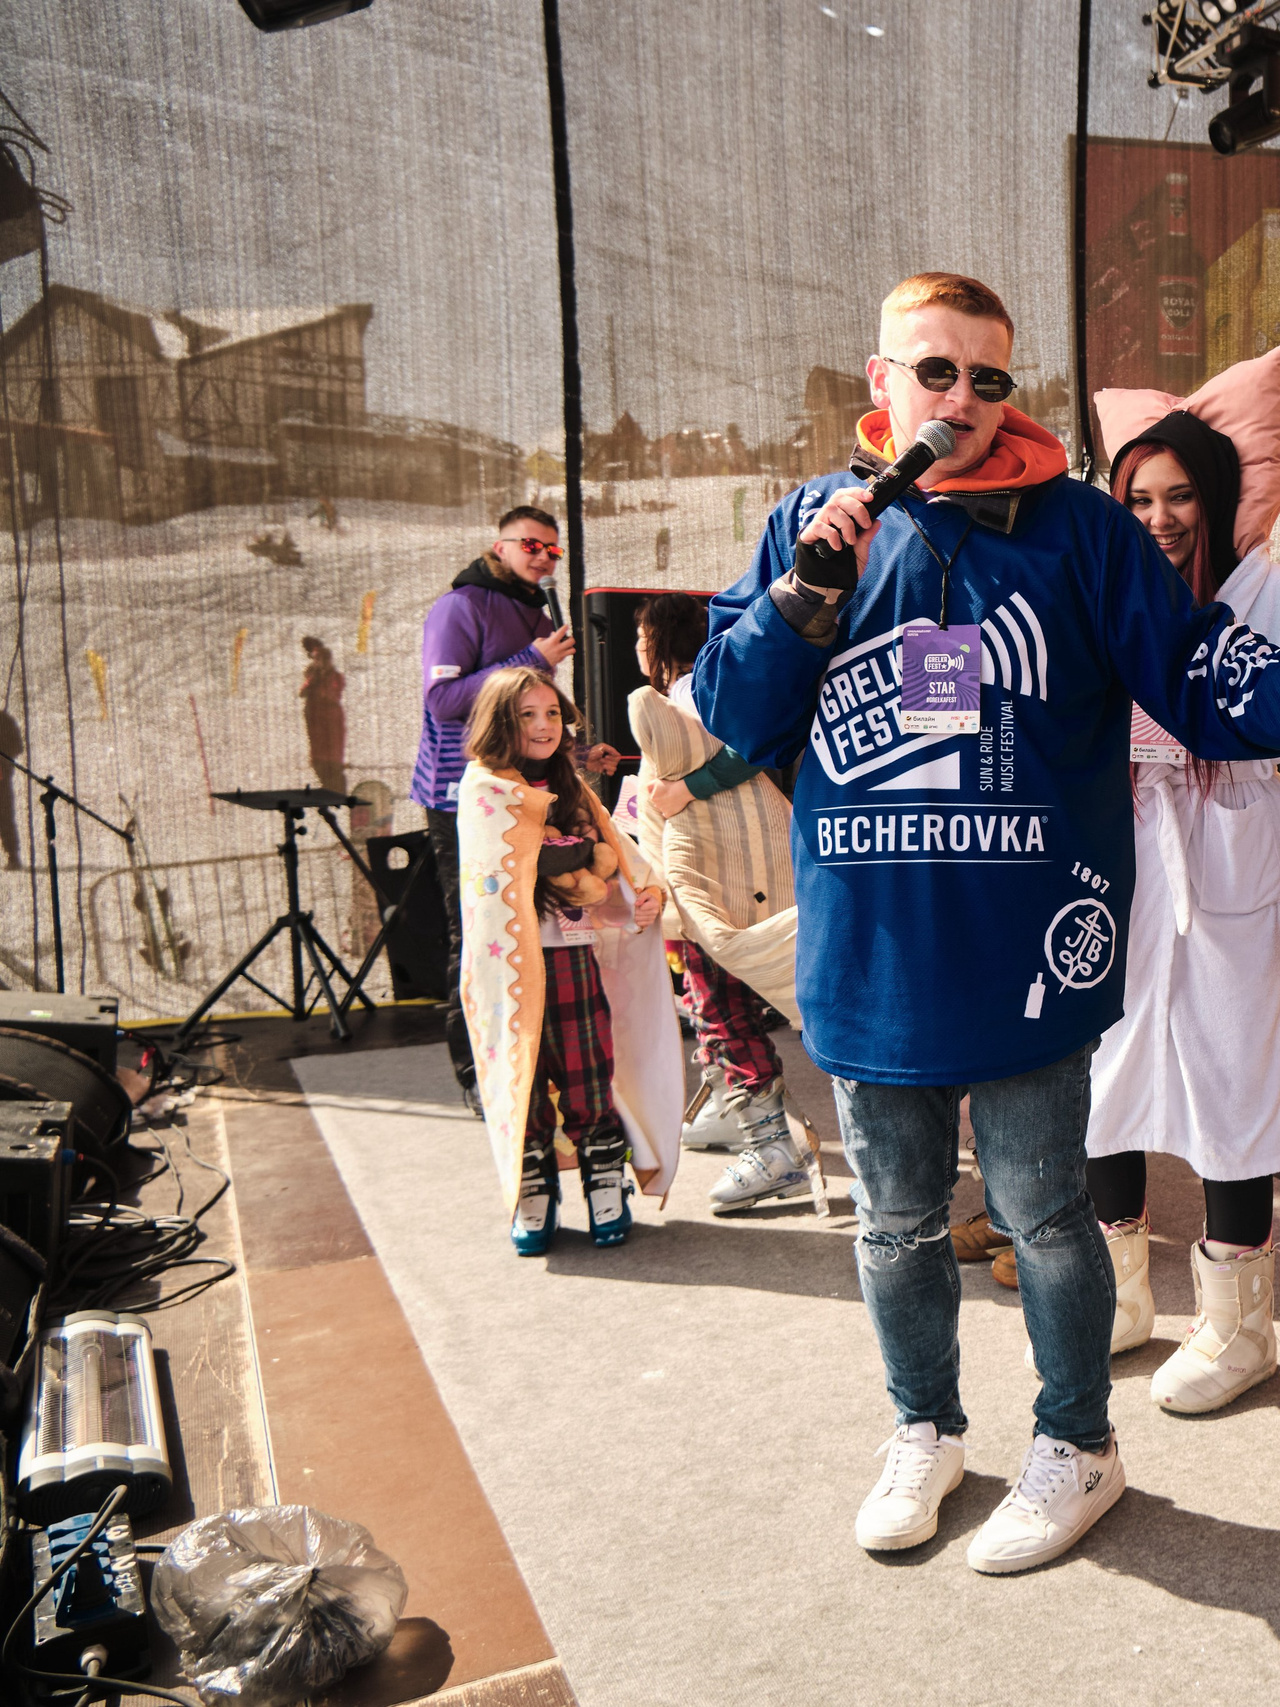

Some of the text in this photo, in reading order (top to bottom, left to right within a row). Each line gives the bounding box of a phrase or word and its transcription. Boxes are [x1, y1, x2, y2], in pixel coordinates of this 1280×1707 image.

[1162, 296, 1196, 307] ROYAL
[820, 644, 903, 723] GRELK
[928, 681, 956, 694] STAR
[979, 726, 994, 792] SUN & RIDE
[1000, 700, 1014, 792] MUSIC FESTIVAL
[817, 813, 1046, 857] BECHEROVKA
[1071, 861, 1111, 895] 1807
